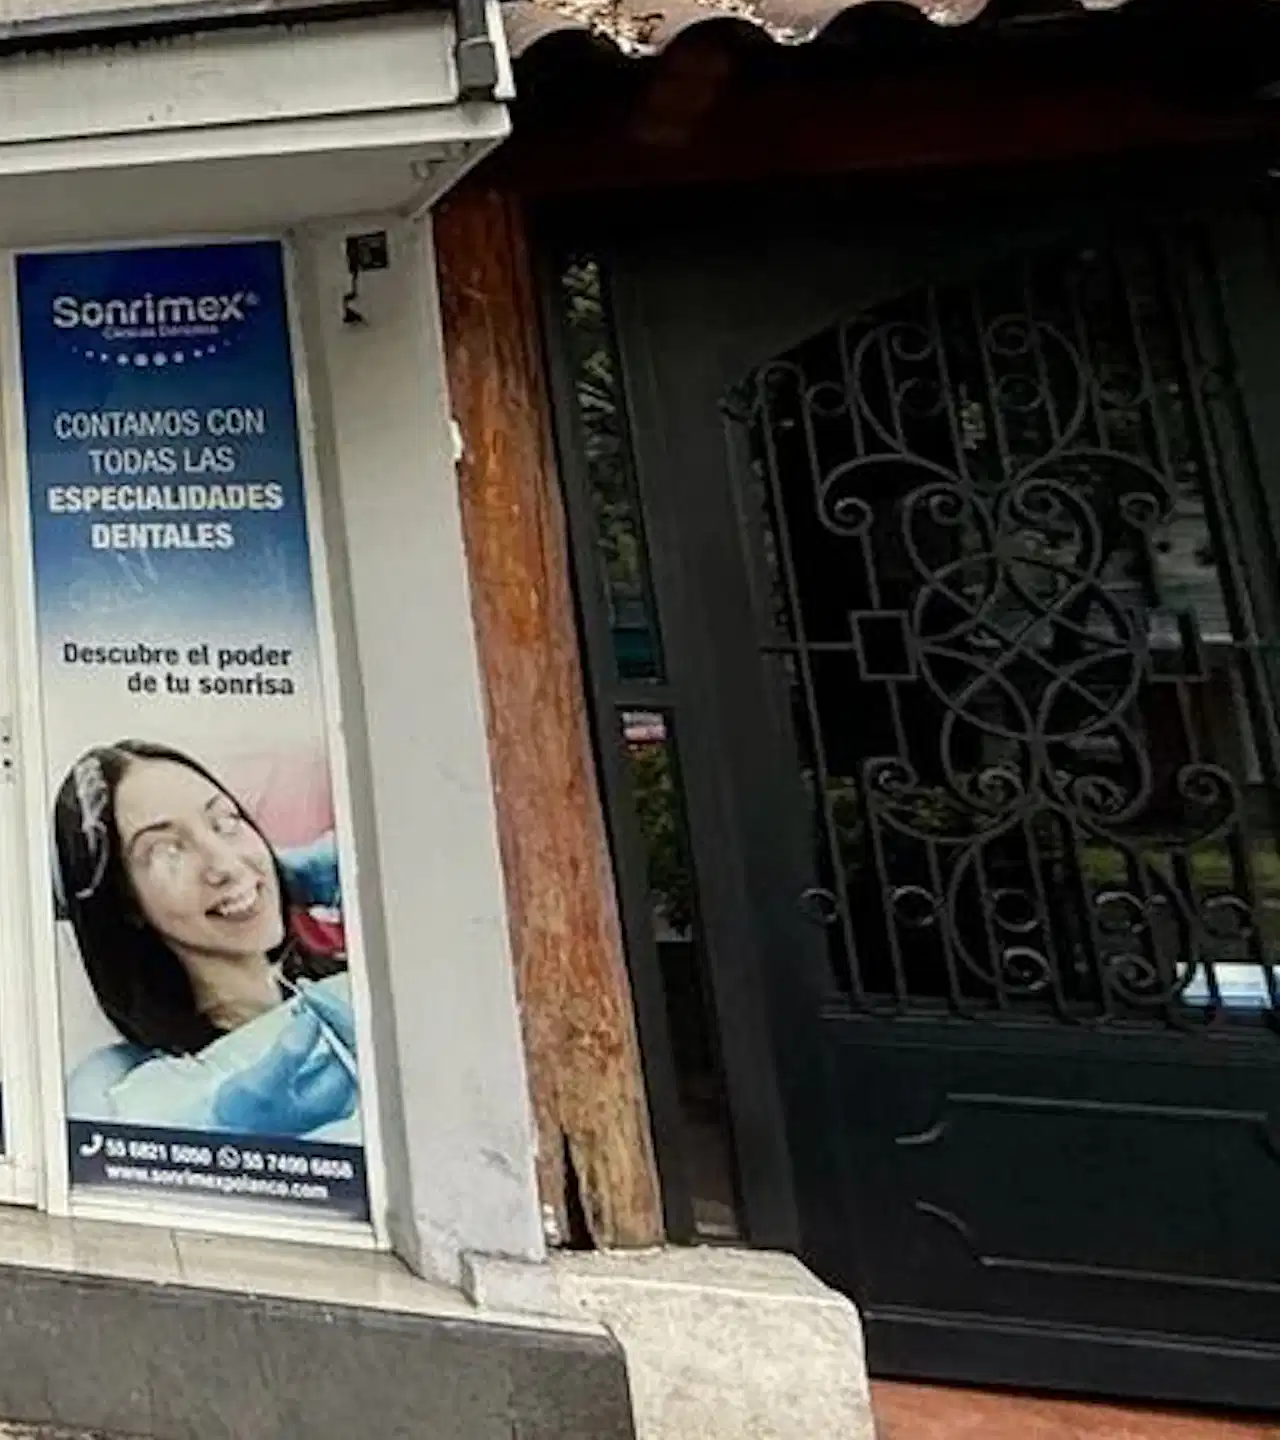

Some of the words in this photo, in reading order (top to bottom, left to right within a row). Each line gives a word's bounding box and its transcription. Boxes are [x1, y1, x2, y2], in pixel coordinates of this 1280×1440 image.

[54, 409, 201, 440] CONTAMOS
[206, 408, 265, 436] CON
[89, 446, 177, 476] TODAS
[183, 445, 236, 474] LAS
[46, 482, 284, 514] ESPECIALIDADES
[91, 521, 235, 550] DENTALES
[63, 642, 180, 665] Descubre
[186, 644, 209, 666] el
[217, 644, 293, 670] poder
[127, 672, 157, 693] de
[166, 672, 191, 694] tu
[198, 673, 295, 696] sonrisa
